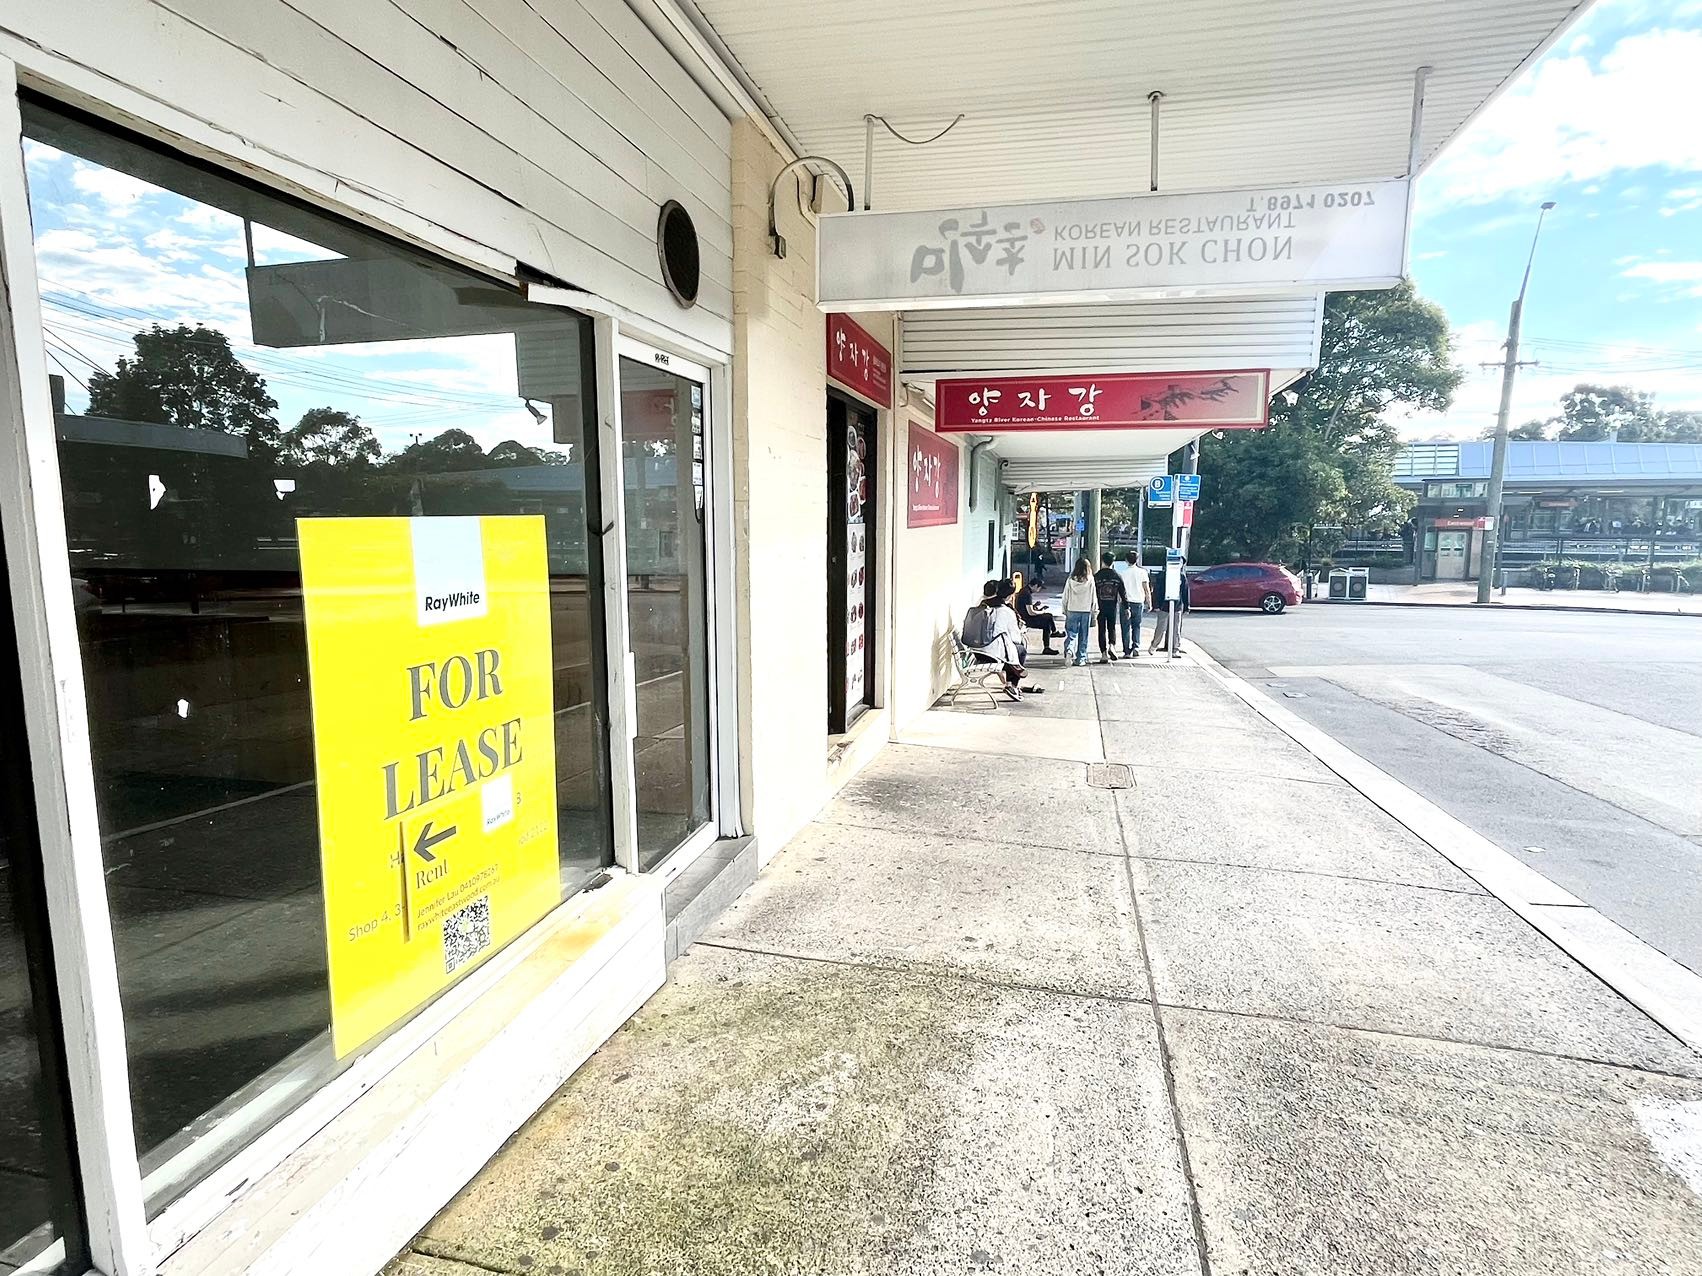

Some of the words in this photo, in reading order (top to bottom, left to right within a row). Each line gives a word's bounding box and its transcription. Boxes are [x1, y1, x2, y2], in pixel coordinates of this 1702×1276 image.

[406, 649, 503, 722] FOR
[382, 718, 523, 820] LEASE
[415, 858, 449, 890] Rent
[417, 895, 445, 919] Jennifer
[446, 888, 459, 902] Lau
[348, 917, 378, 942] Shop
